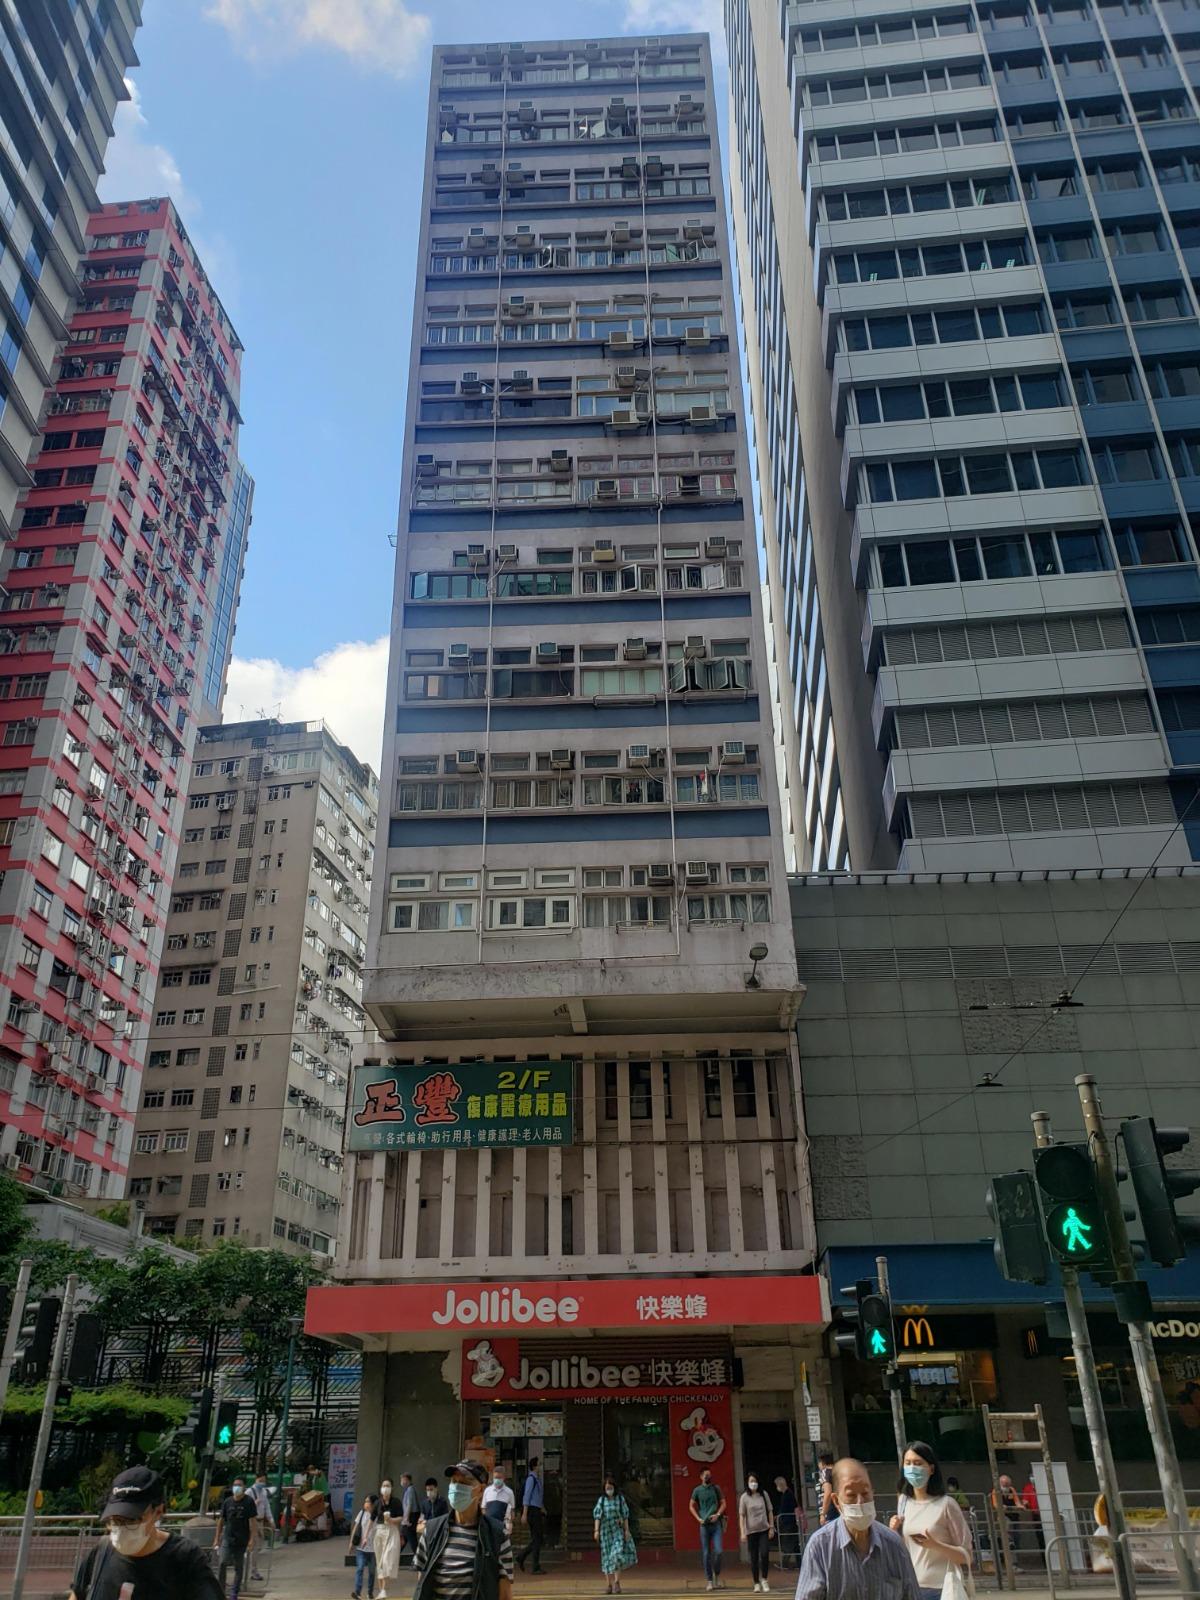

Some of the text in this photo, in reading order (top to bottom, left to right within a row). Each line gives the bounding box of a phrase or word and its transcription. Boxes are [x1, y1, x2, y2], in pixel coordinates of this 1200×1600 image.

[497, 1069, 551, 1090] 2/F
[467, 1092, 567, 1119] 復康醫療用品
[432, 1287, 579, 1325] Jollibee
[636, 1294, 708, 1320] 快樂蜂
[509, 1355, 641, 1389] Jollibee
[648, 1358, 726, 1386] 快樂蜂
[574, 1397, 599, 1405] HOME
[615, 1396, 631, 1404] THE
[631, 1396, 668, 1404] FAMOUS
[670, 1394, 725, 1402] CHICKENJOY
